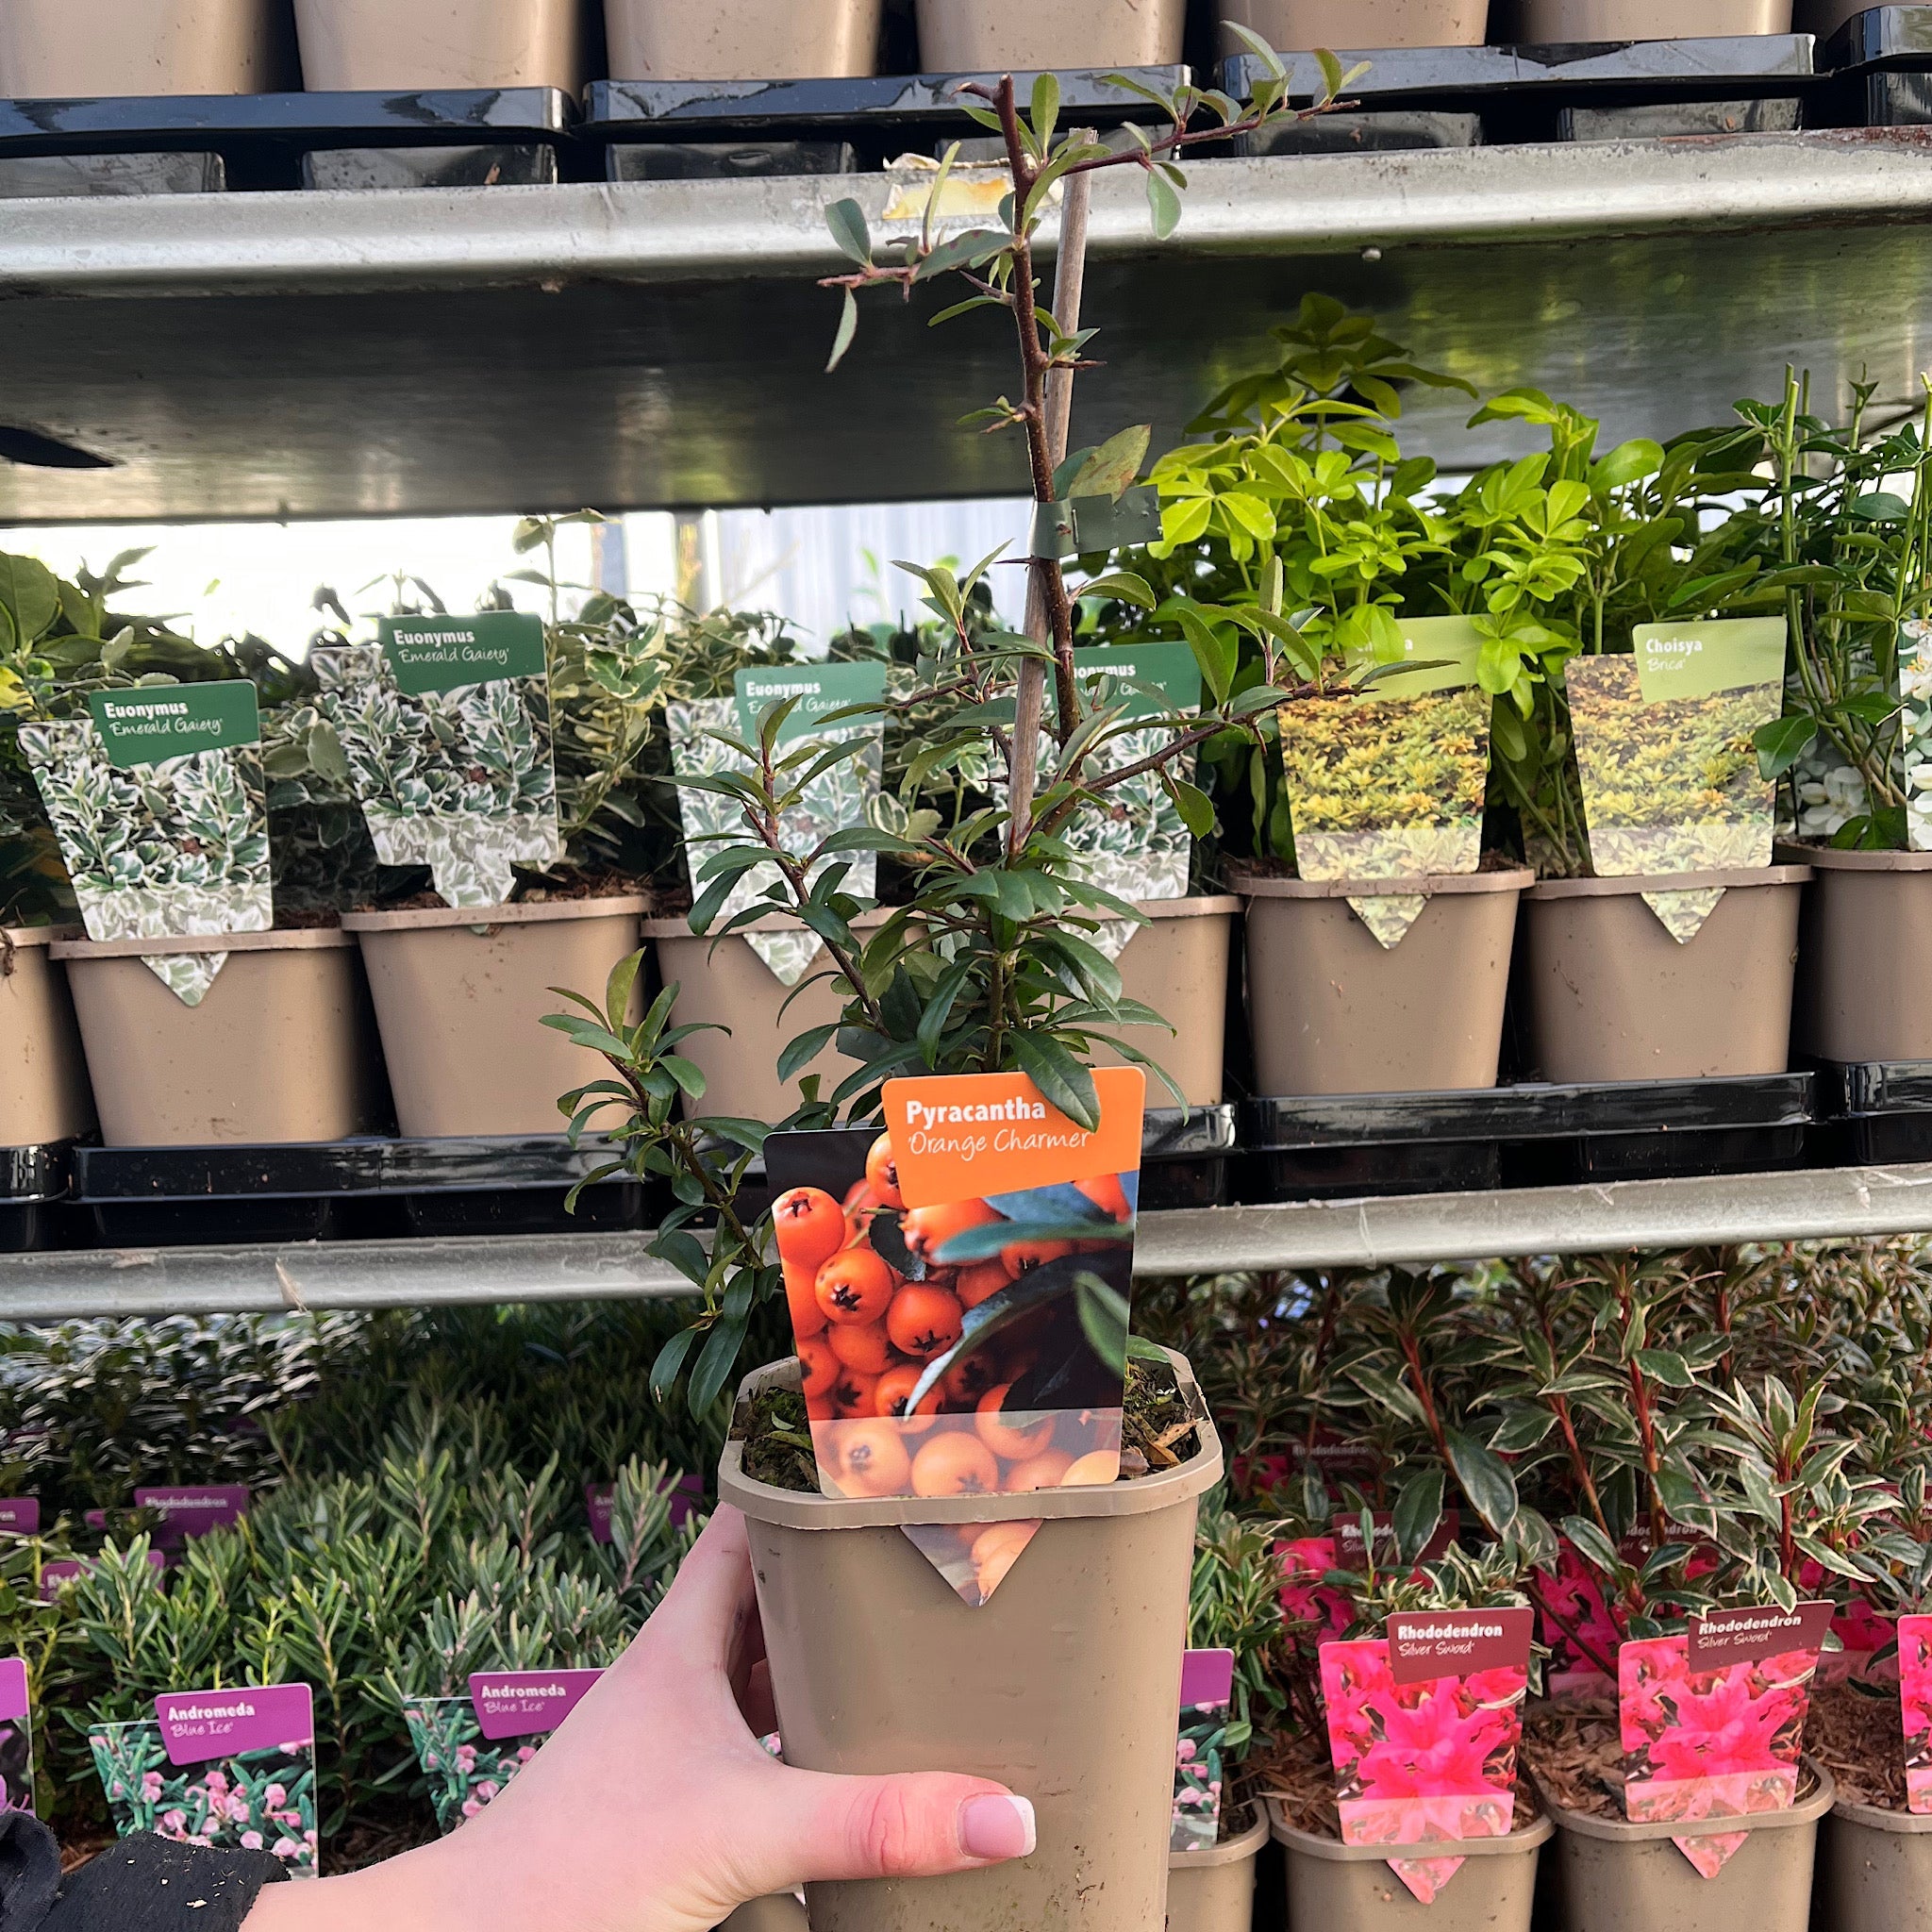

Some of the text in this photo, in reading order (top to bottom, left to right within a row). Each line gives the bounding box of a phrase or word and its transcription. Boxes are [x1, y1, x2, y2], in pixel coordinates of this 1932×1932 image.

[392, 629, 475, 647] Euonymus
[1645, 638, 1703, 657] Choisya
[745, 681, 822, 700] Euonymus
[104, 702, 189, 720] Euonymus
[906, 1096, 1046, 1130] Pyracantha
[1397, 1623, 1503, 1640] Rhododendron
[1699, 1615, 1802, 1635] Rhododendron
[481, 1684, 567, 1699] Andromeda
[168, 1702, 256, 1722] Andromeda
